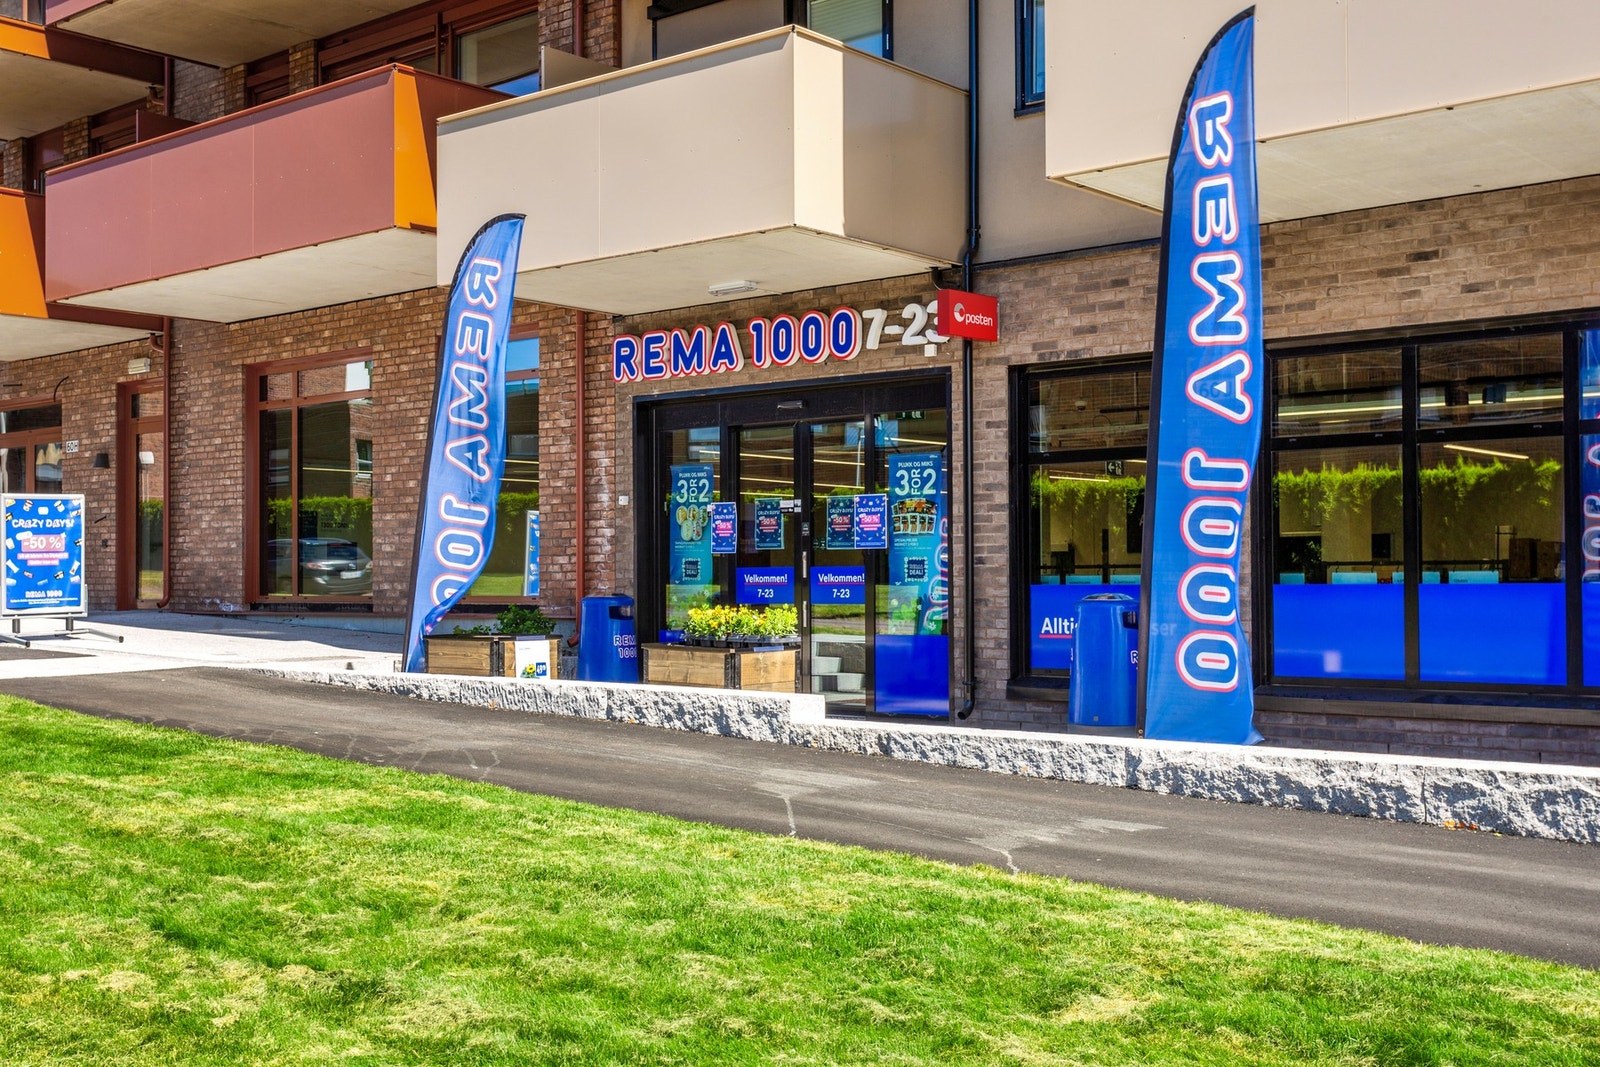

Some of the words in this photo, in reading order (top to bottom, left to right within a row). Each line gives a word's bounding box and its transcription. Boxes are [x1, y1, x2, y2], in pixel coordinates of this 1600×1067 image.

[965, 313, 993, 326] posten
[612, 321, 744, 383] REMA
[748, 306, 862, 369] 1000
[895, 469, 910, 496] 3
[911, 469, 921, 495] FOR
[922, 468, 937, 495] 2
[676, 479, 688, 503] 3
[689, 479, 698, 503] FOR
[698, 479, 709, 503] 2
[11, 519, 44, 528] CRAZY
[862, 515, 872, 523] -50
[23, 537, 47, 549] -50
[50, 537, 61, 549] %
[744, 574, 788, 583] Velkommen!
[818, 573, 865, 583] Velkommen!
[757, 589, 774, 598] 7-23
[832, 589, 850, 598] 7-23
